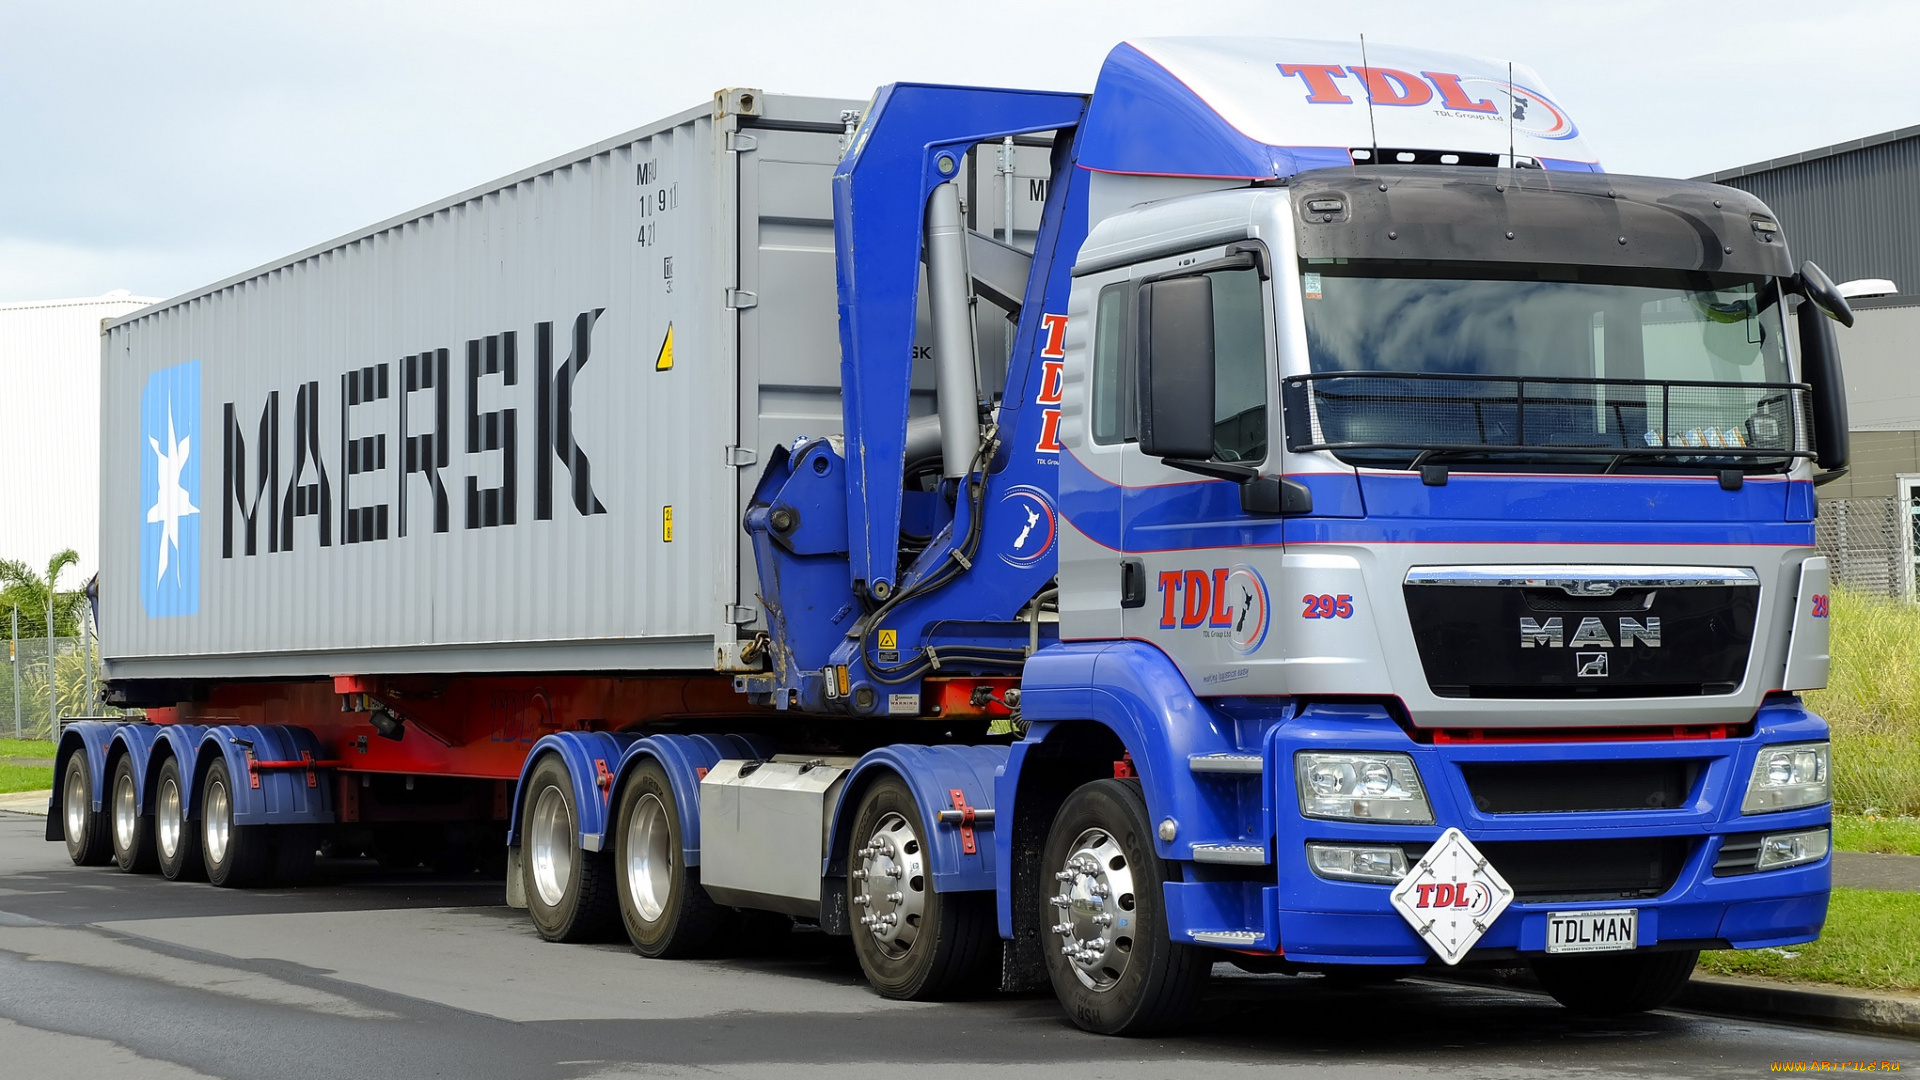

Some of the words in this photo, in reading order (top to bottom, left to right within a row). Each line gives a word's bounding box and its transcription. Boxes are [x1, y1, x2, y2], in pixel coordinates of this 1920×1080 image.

[1276, 63, 1498, 114] TDL
[1455, 112, 1485, 120] Group
[1030, 179, 1049, 201] M
[222, 307, 608, 558] MAERSK
[1158, 568, 1234, 629] TDL
[1302, 594, 1354, 619] 295
[1812, 594, 1829, 618] 29
[1211, 631, 1223, 639] Group
[1520, 617, 1661, 648] MAN
[1416, 883, 1470, 908] TDL
[1552, 917, 1632, 943] TDLMAN
